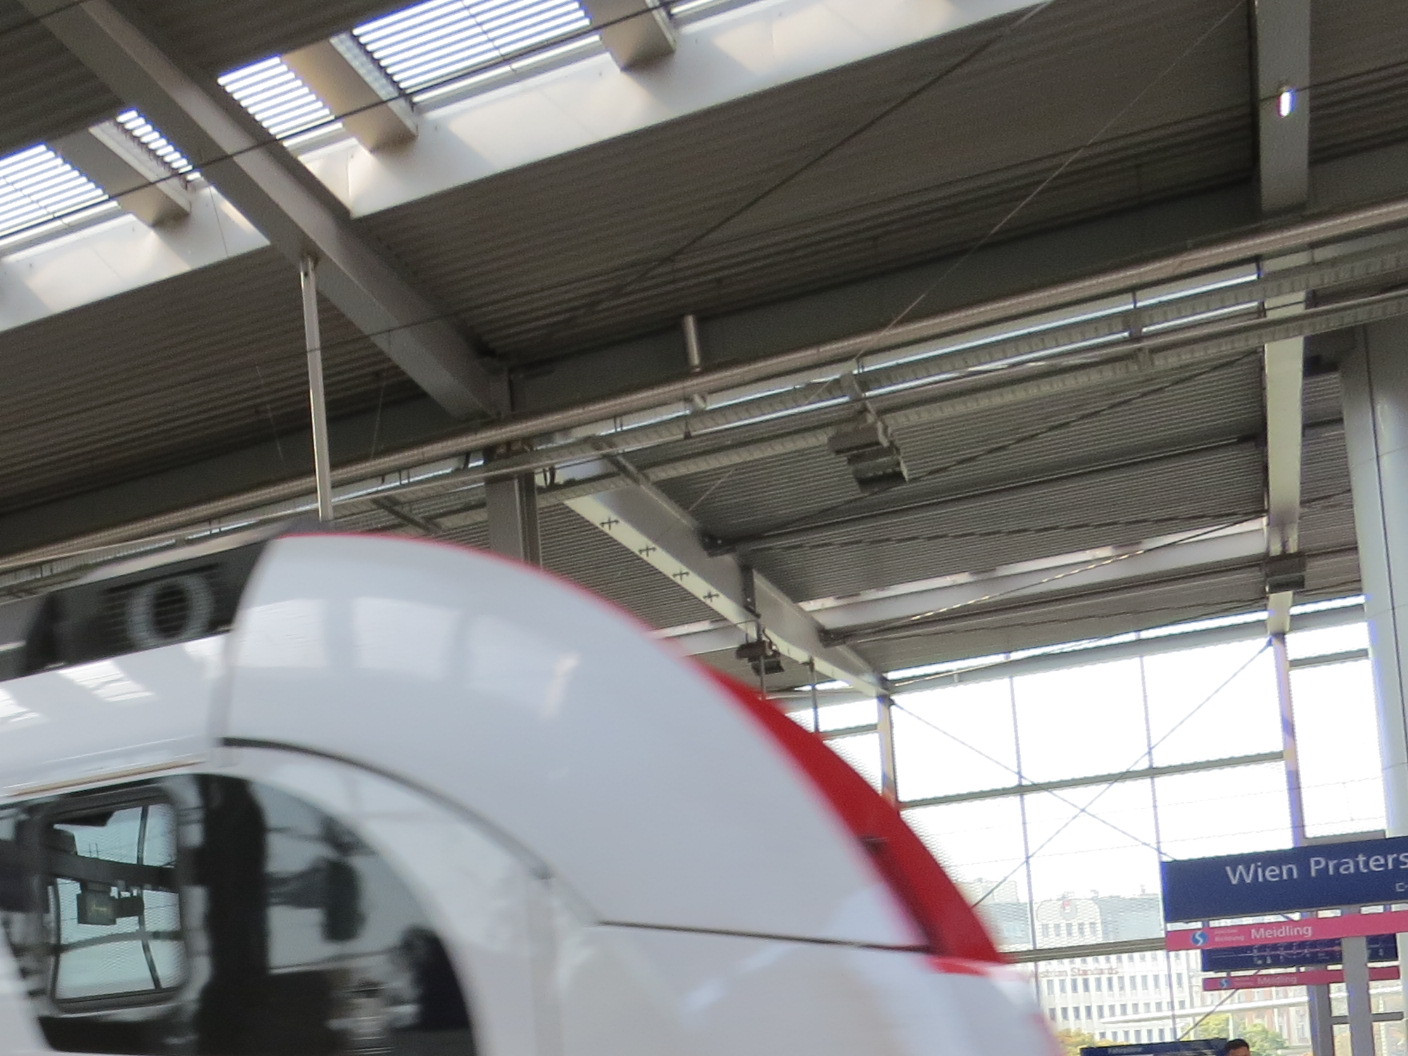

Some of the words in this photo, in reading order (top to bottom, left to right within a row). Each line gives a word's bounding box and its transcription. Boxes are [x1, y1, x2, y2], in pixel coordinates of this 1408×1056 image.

[1225, 862, 1298, 885] Wien
[1309, 852, 1408, 877] Praters
[1251, 925, 1312, 940] Meidling
